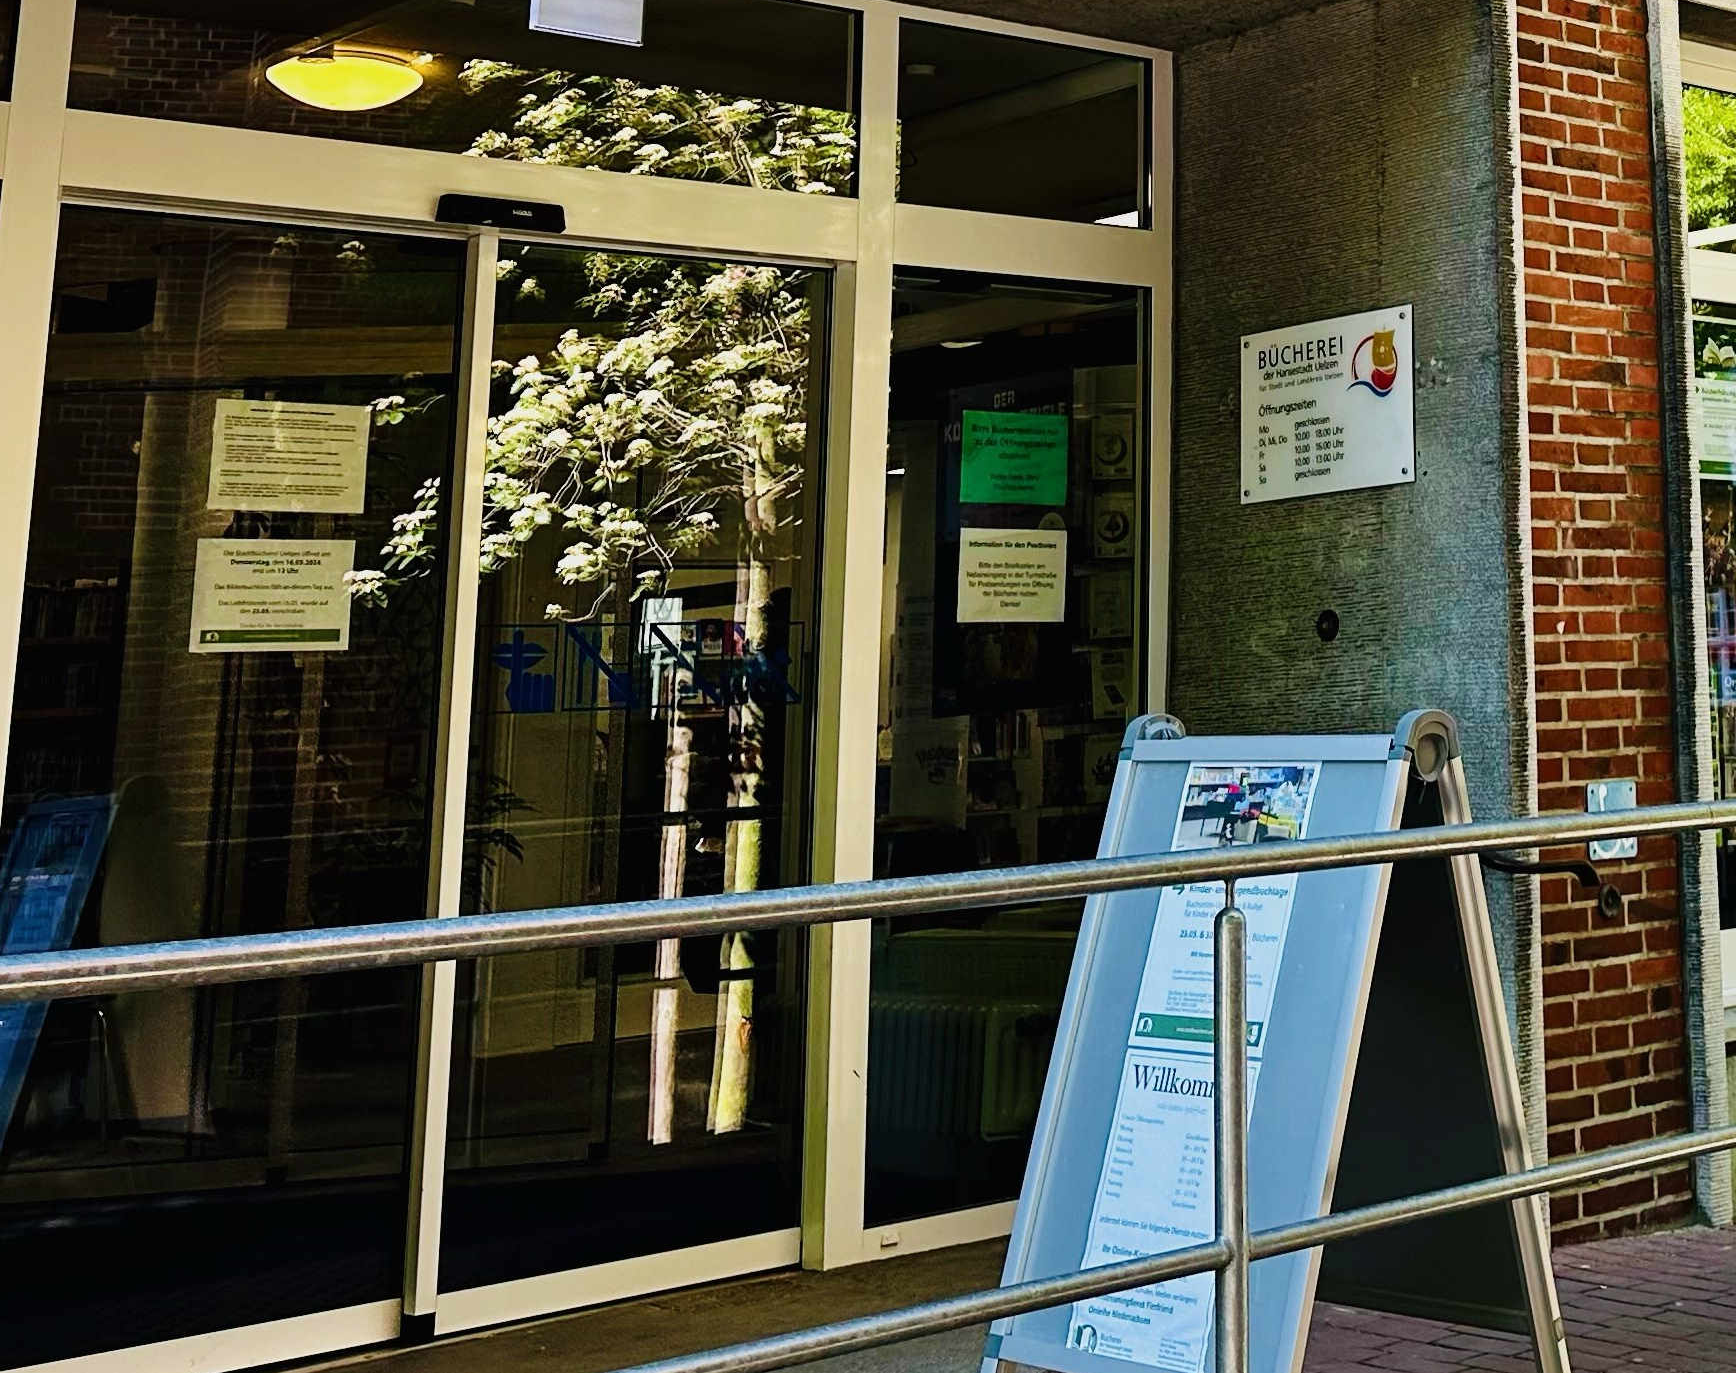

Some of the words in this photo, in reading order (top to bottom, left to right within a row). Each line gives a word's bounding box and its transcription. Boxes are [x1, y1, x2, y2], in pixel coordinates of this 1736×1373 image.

[1258, 335, 1343, 370] BÜCHEREI
[1263, 370, 1274, 380] der
[1275, 363, 1314, 378] Hansestadt
[1258, 399, 1317, 417] Öffnungszeiten
[1258, 425, 1270, 434] Mo
[1332, 426, 1344, 436] Uhr
[1332, 439, 1344, 448] Uhr
[1332, 451, 1344, 461] Uhr
[1133, 1063, 1214, 1099] Willkom
